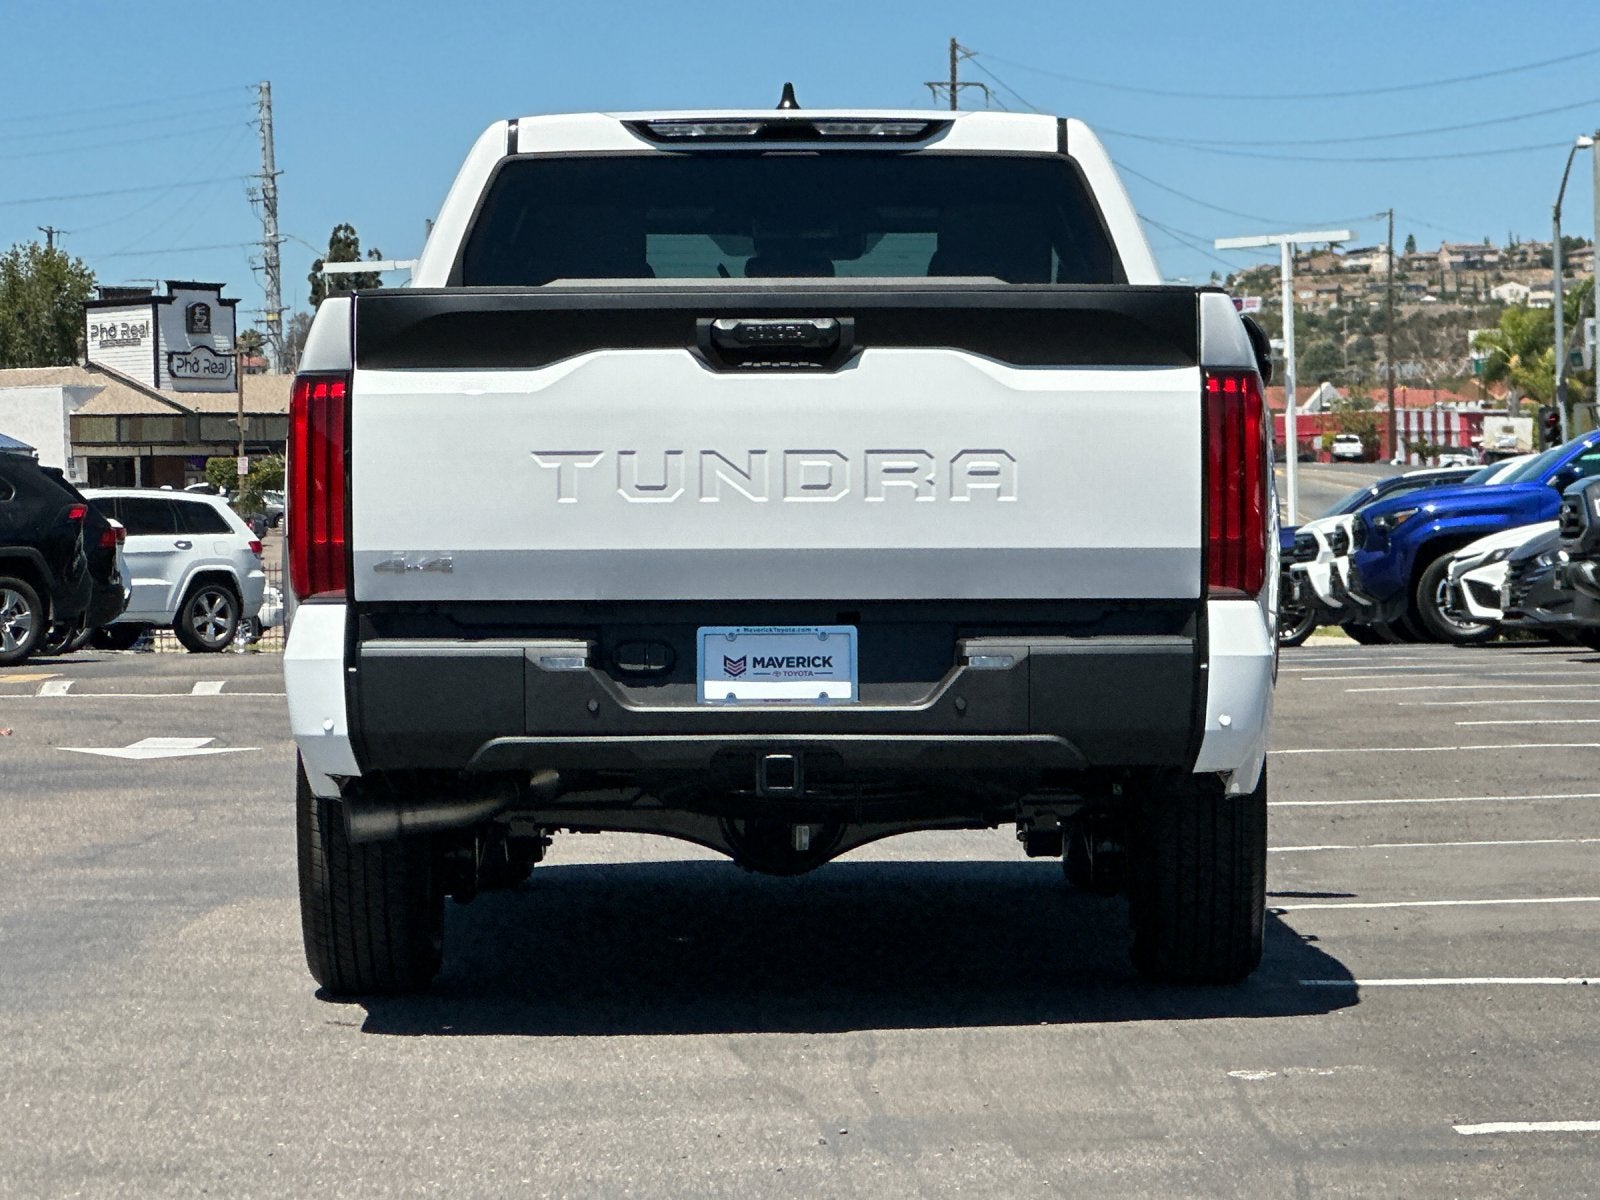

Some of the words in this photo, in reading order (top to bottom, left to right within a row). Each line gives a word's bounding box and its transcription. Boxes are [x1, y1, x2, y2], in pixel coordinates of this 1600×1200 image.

[121, 320, 150, 339] Real
[203, 359, 227, 374] Real
[530, 449, 1018, 504] TUNDRA
[752, 655, 833, 669] MAVERICK
